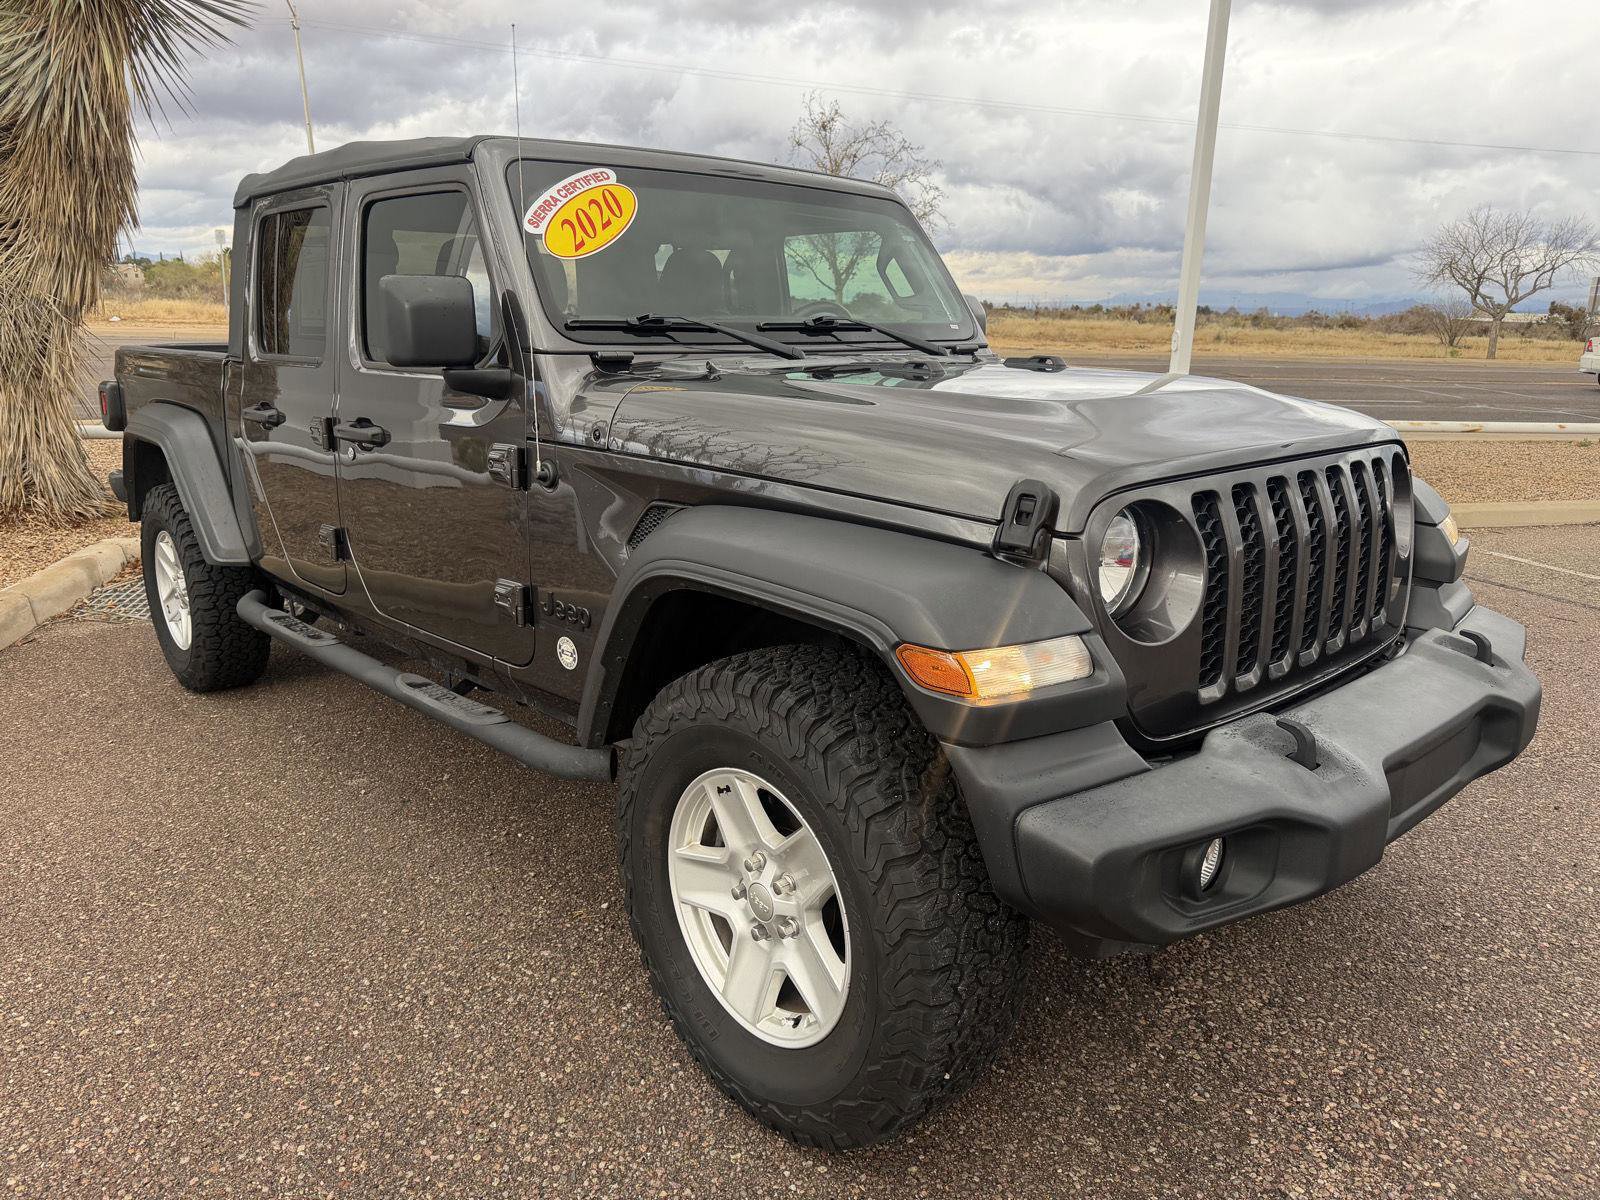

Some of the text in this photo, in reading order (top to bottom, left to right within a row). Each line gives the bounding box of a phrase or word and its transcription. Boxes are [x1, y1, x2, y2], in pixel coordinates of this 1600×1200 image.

[527, 171, 611, 229] SIERRA CERTIFIED
[561, 188, 623, 253] 2020
[540, 591, 592, 632] Jeep
